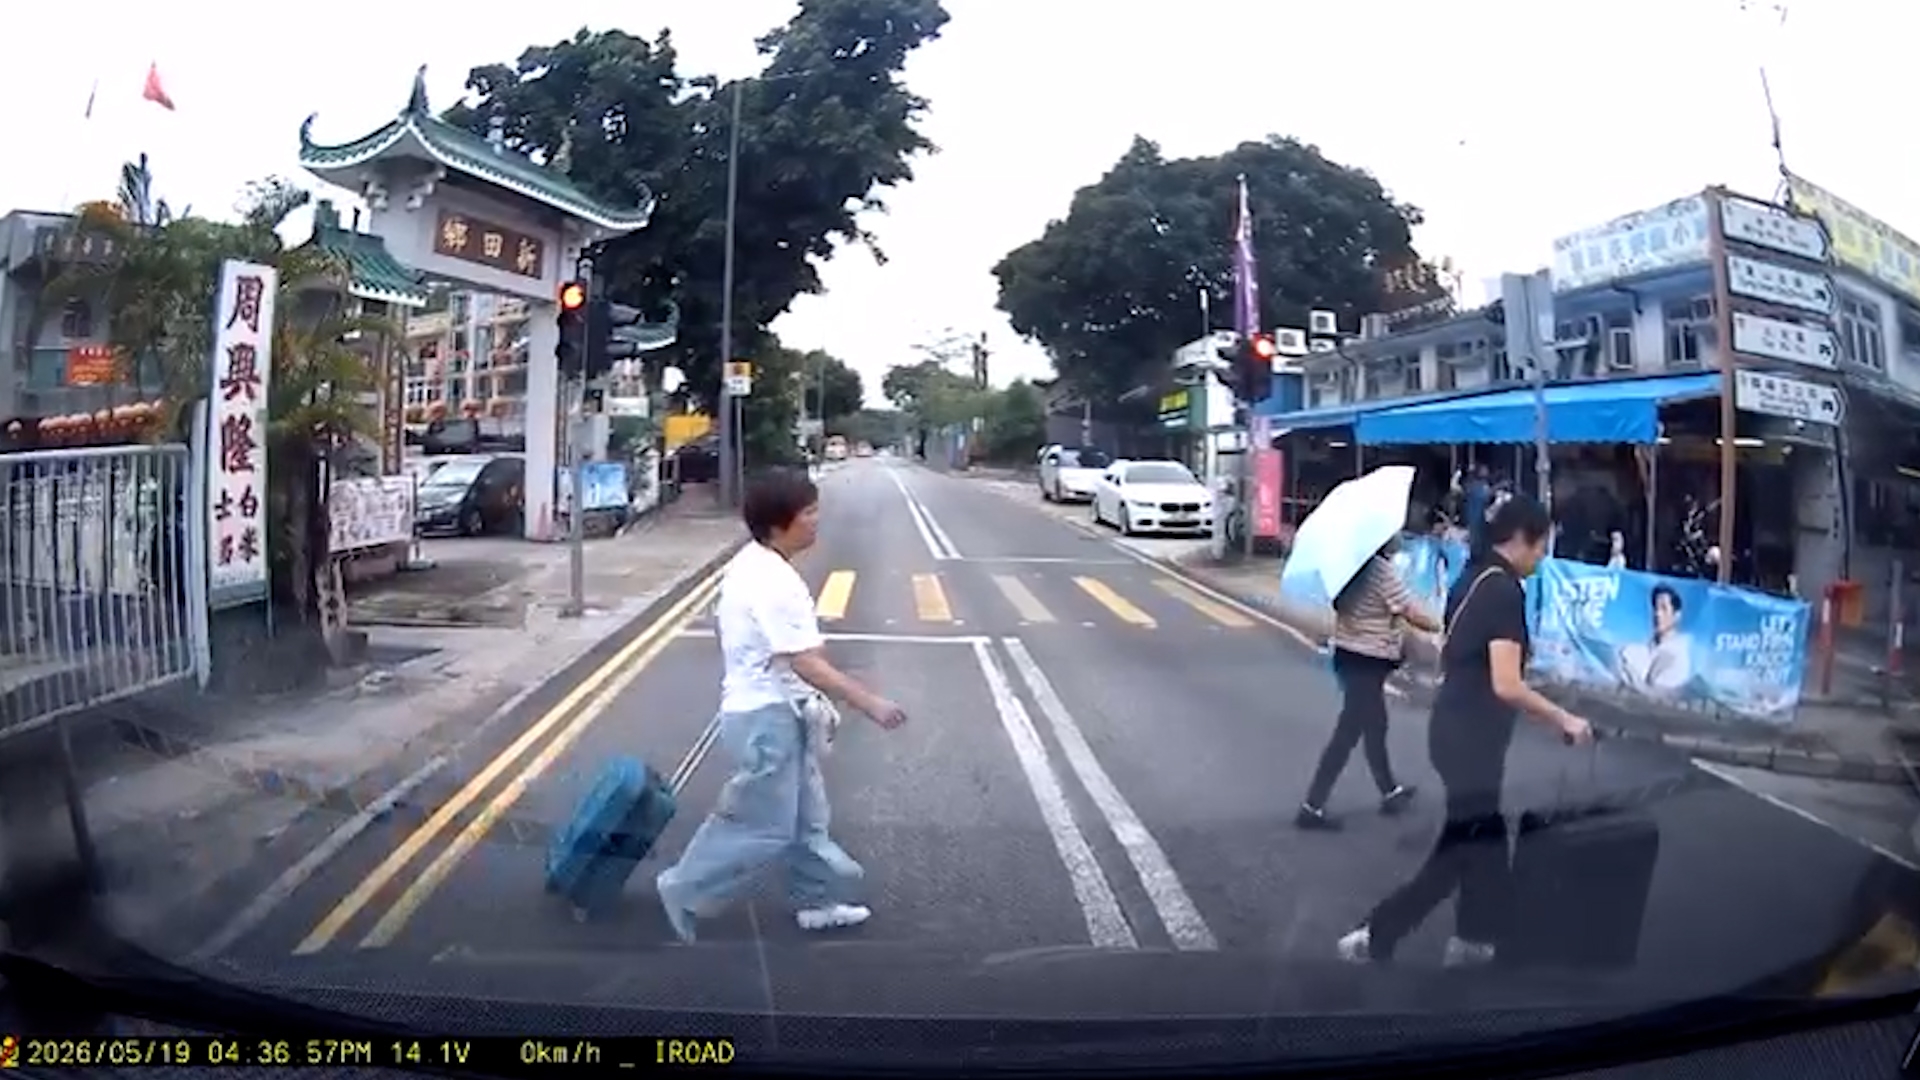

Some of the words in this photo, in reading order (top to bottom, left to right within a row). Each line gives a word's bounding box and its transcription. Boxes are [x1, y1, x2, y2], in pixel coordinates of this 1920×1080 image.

[220, 275, 264, 474] 周興隆
[239, 484, 259, 563] 白米
